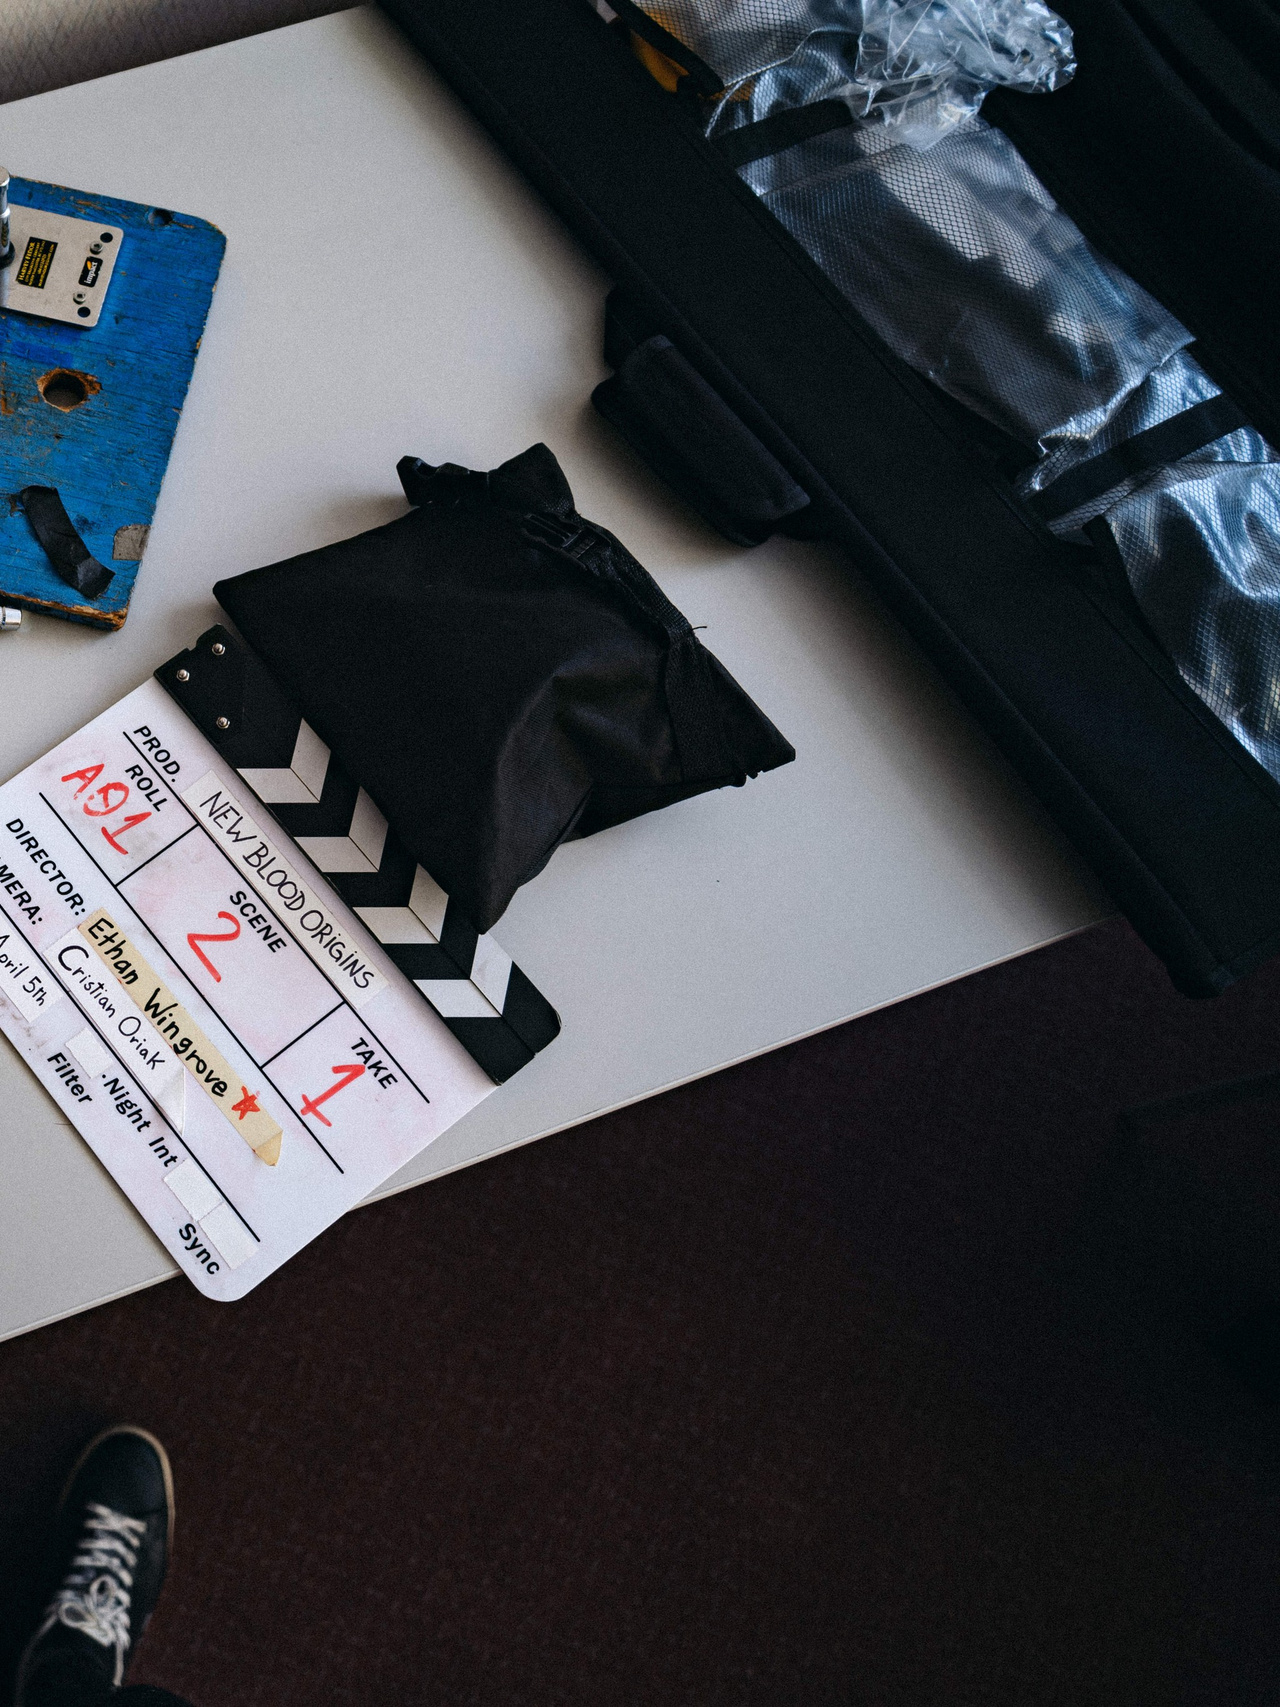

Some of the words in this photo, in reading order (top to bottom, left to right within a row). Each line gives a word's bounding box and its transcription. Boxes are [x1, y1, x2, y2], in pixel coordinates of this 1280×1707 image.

[133, 725, 181, 783] PROD.
[124, 764, 168, 812] ROLL
[5, 818, 86, 916] DIRECTOR:
[199, 790, 258, 843] NEW
[242, 841, 306, 911] BLOOD
[186, 910, 241, 983] 2
[229, 890, 288, 953] SCENE
[22, 975, 47, 1006] 5th
[57, 945, 116, 1018] Cristian
[87, 917, 139, 985] Ethan
[144, 987, 228, 1098] Wingrove
[47, 1052, 93, 1103] Filter
[351, 1037, 398, 1090] TAKE
[300, 1064, 366, 1127] 1
[148, 1136, 178, 1168] Int
[178, 1223, 220, 1275] Sync
